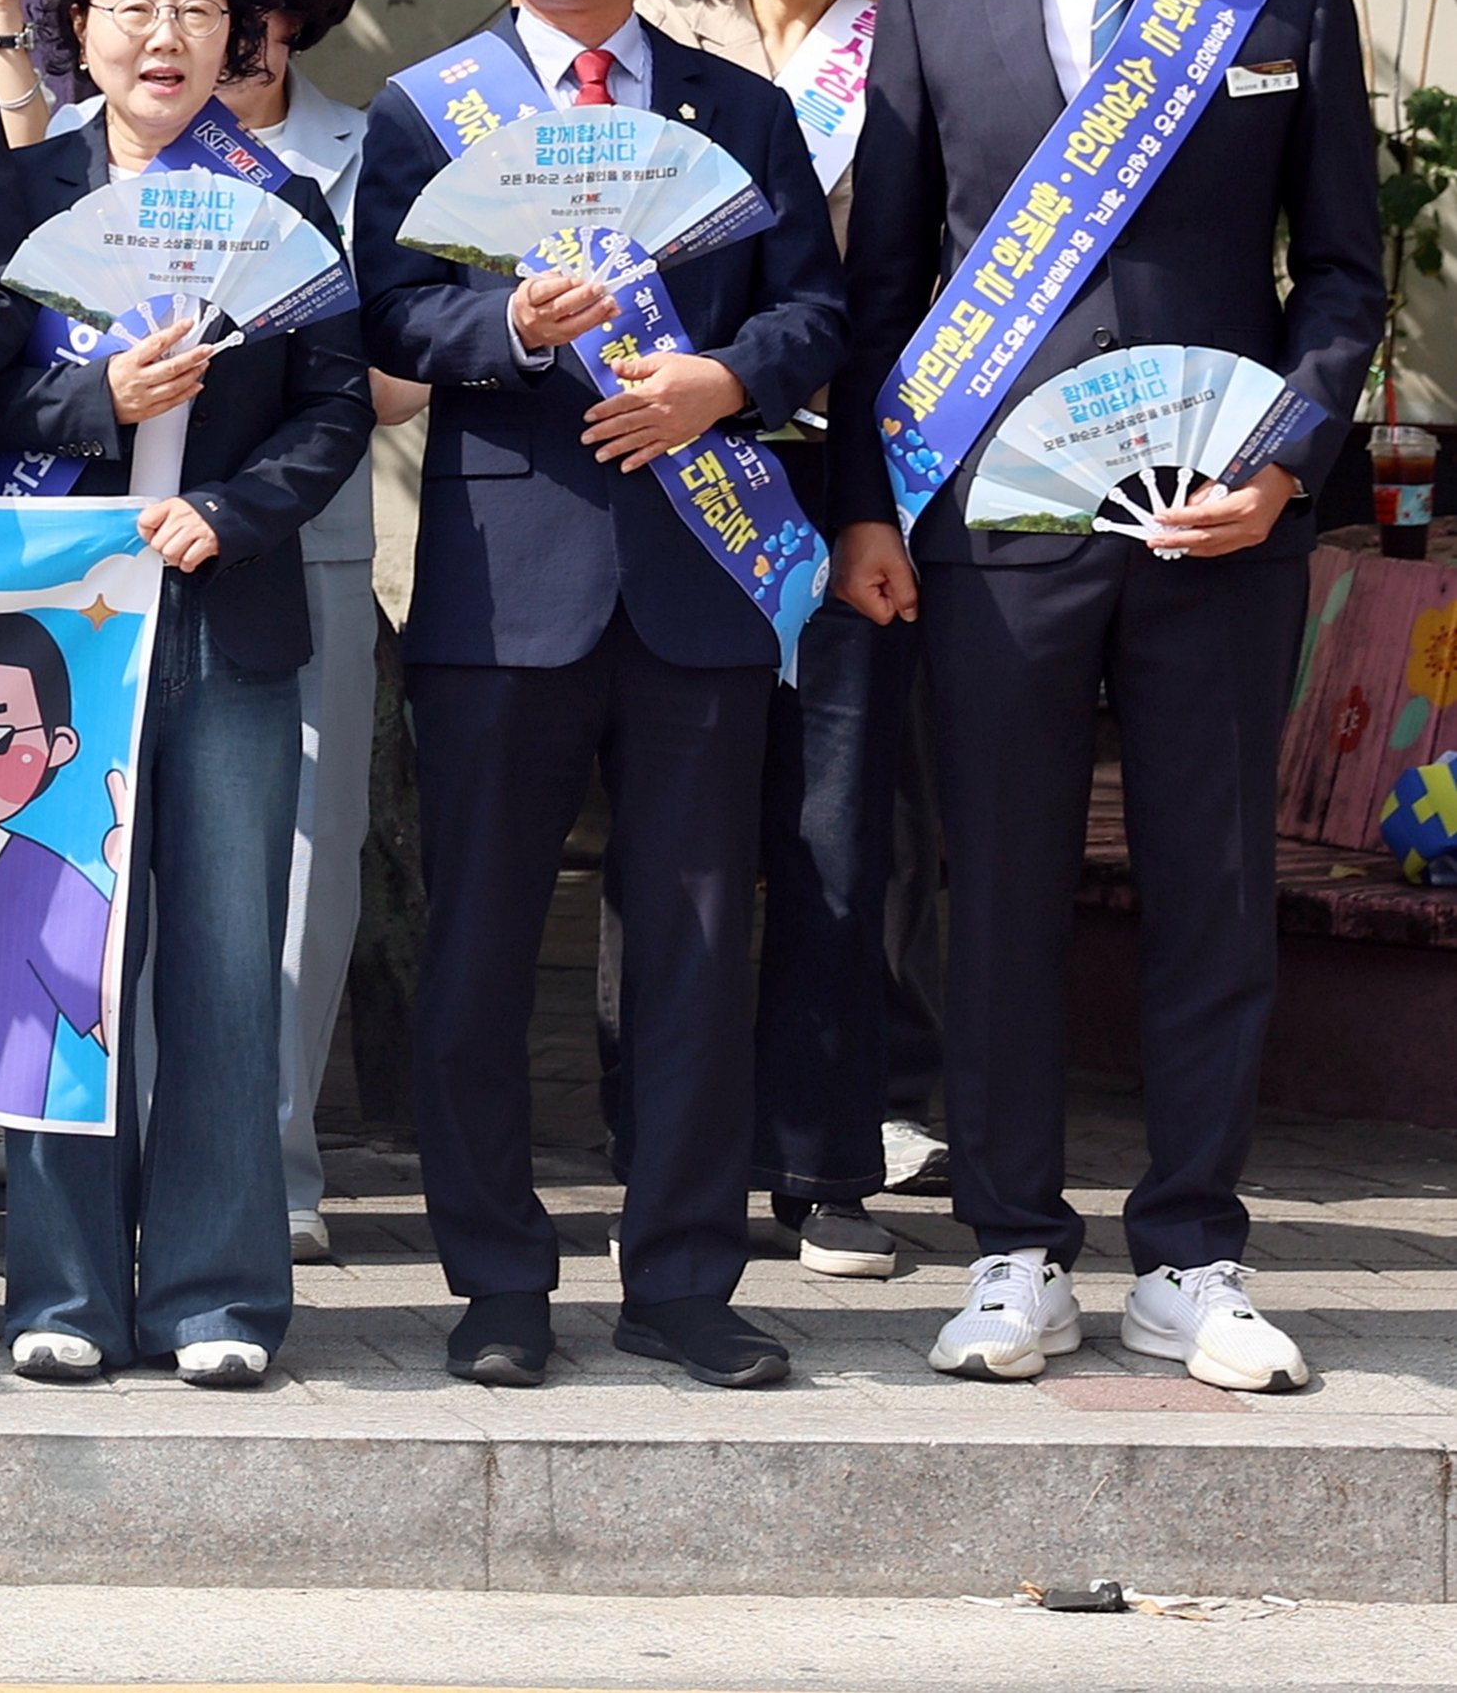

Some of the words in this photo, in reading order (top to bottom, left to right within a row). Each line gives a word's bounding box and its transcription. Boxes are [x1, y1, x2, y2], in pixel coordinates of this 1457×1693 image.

[1186, 8, 1237, 86] 소상공인이
[535, 120, 638, 146] 함께합시다
[1062, 56, 1158, 177] 소상공인
[1153, 83, 1197, 137] 살아야
[193, 119, 272, 186] KFME
[534, 142, 638, 167] 같이삽시다
[1116, 133, 1163, 189] 화순이
[138, 209, 235, 232] 같이삽시다
[139, 186, 236, 210] 함께합시다
[972, 180, 1074, 307] 함께하는
[1025, 228, 1096, 317] 화순경제도
[897, 299, 996, 423] 대한민국
[964, 313, 1037, 399] 살아납니다.
[1060, 358, 1161, 404] 함께합시다
[1067, 377, 1169, 425] 같이삽시다
[678, 449, 760, 555] 대한민국
